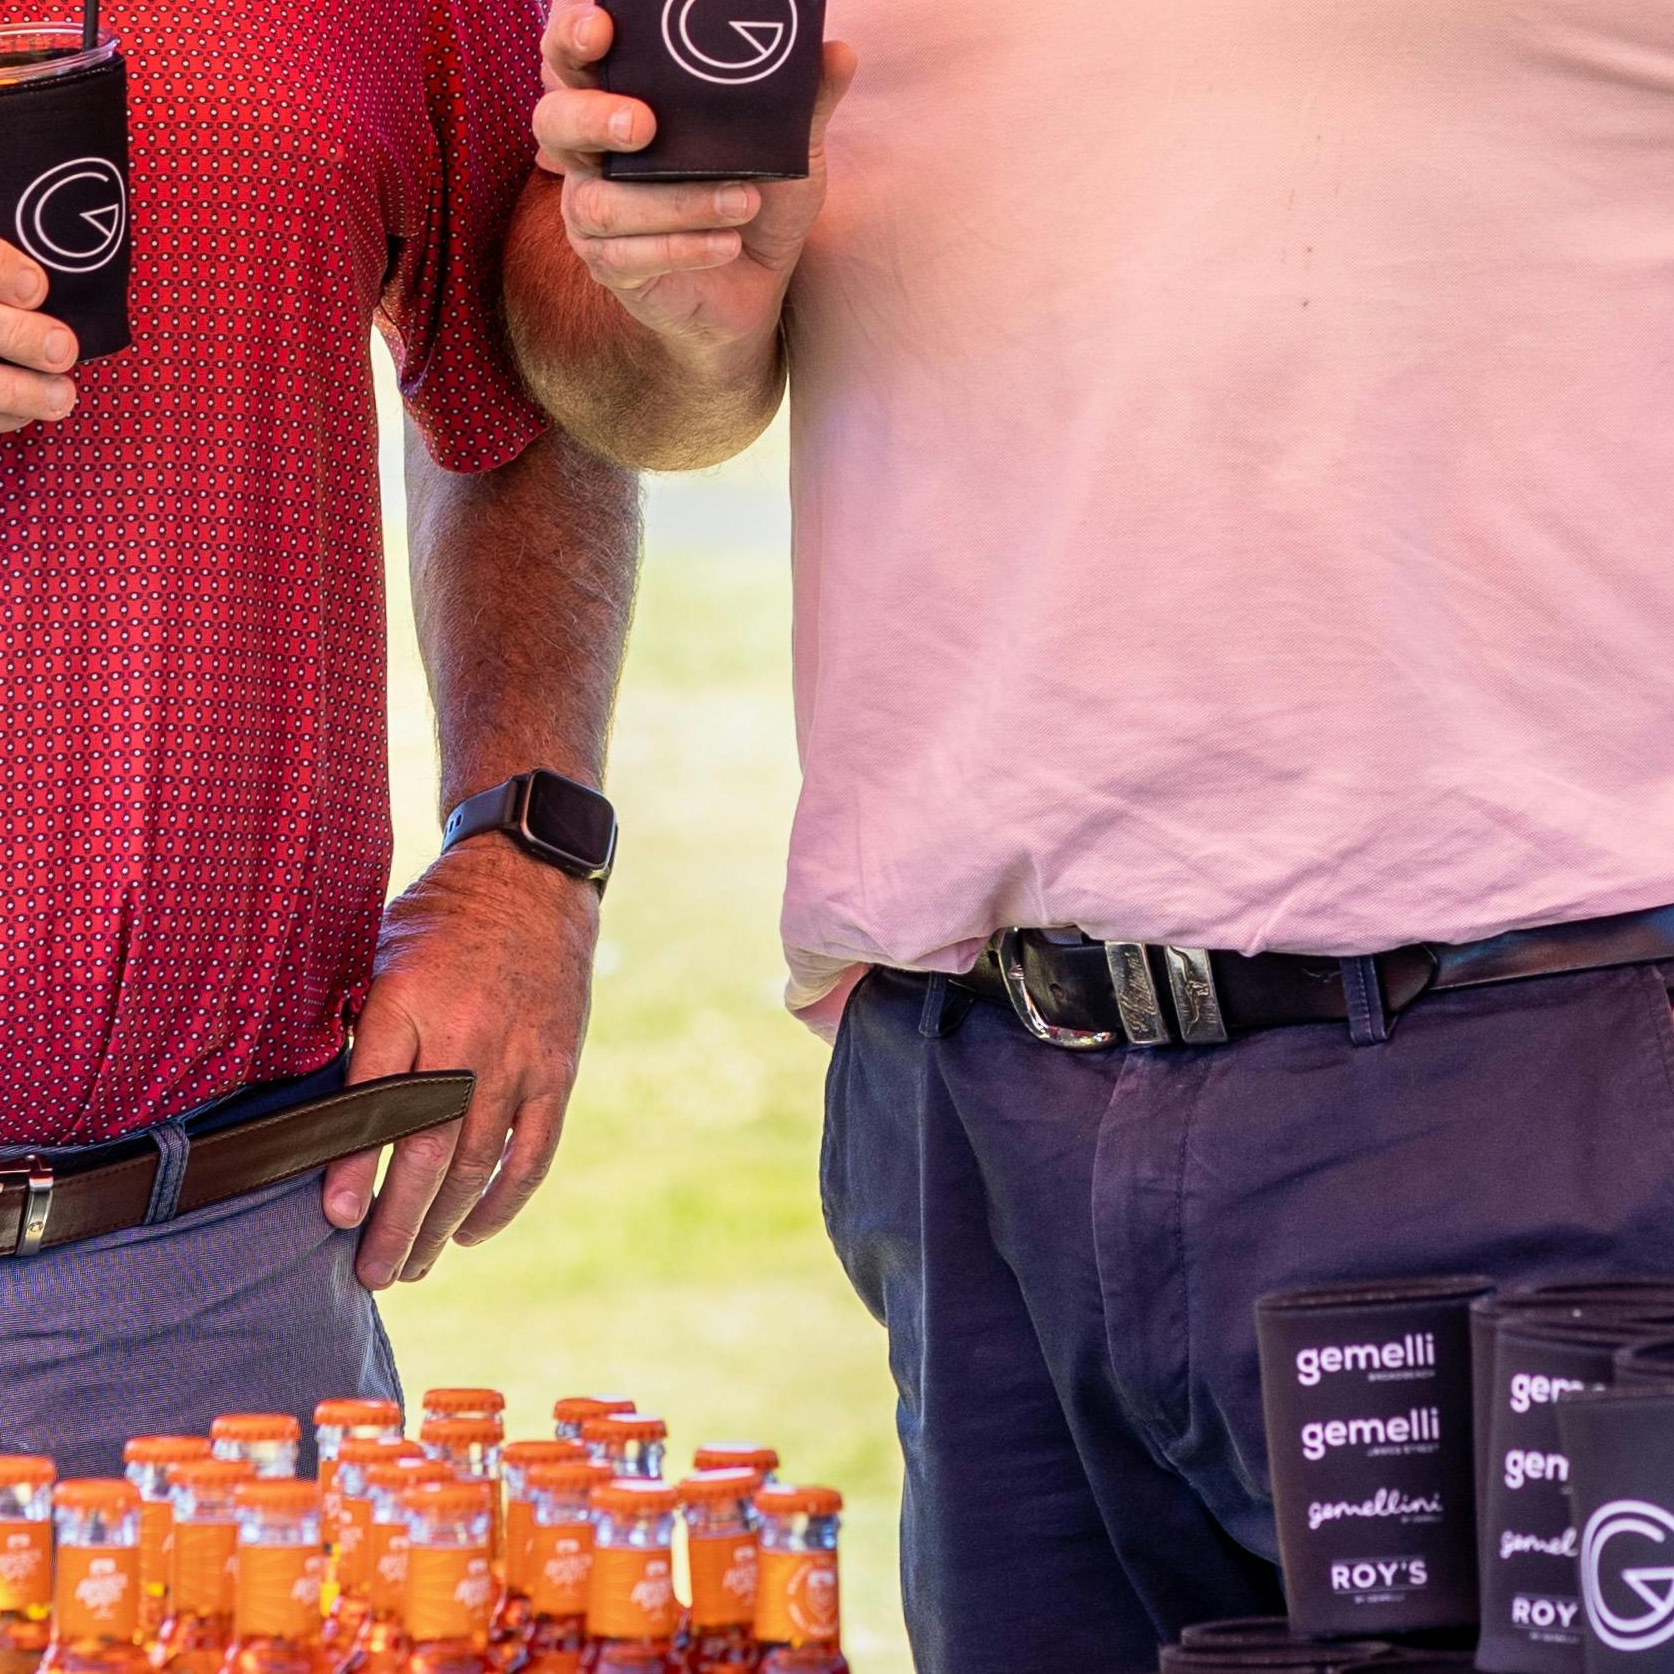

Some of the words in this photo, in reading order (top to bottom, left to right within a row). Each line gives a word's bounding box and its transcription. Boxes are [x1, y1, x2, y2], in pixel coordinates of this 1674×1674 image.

[1295, 1332, 1436, 1386] gemelli
[1300, 1406, 1441, 1461] gemelli
[1307, 1486, 1445, 1530] gemellini
[1330, 1558, 1428, 1591] ROY'S
[1511, 1595, 1579, 1627] ROY
